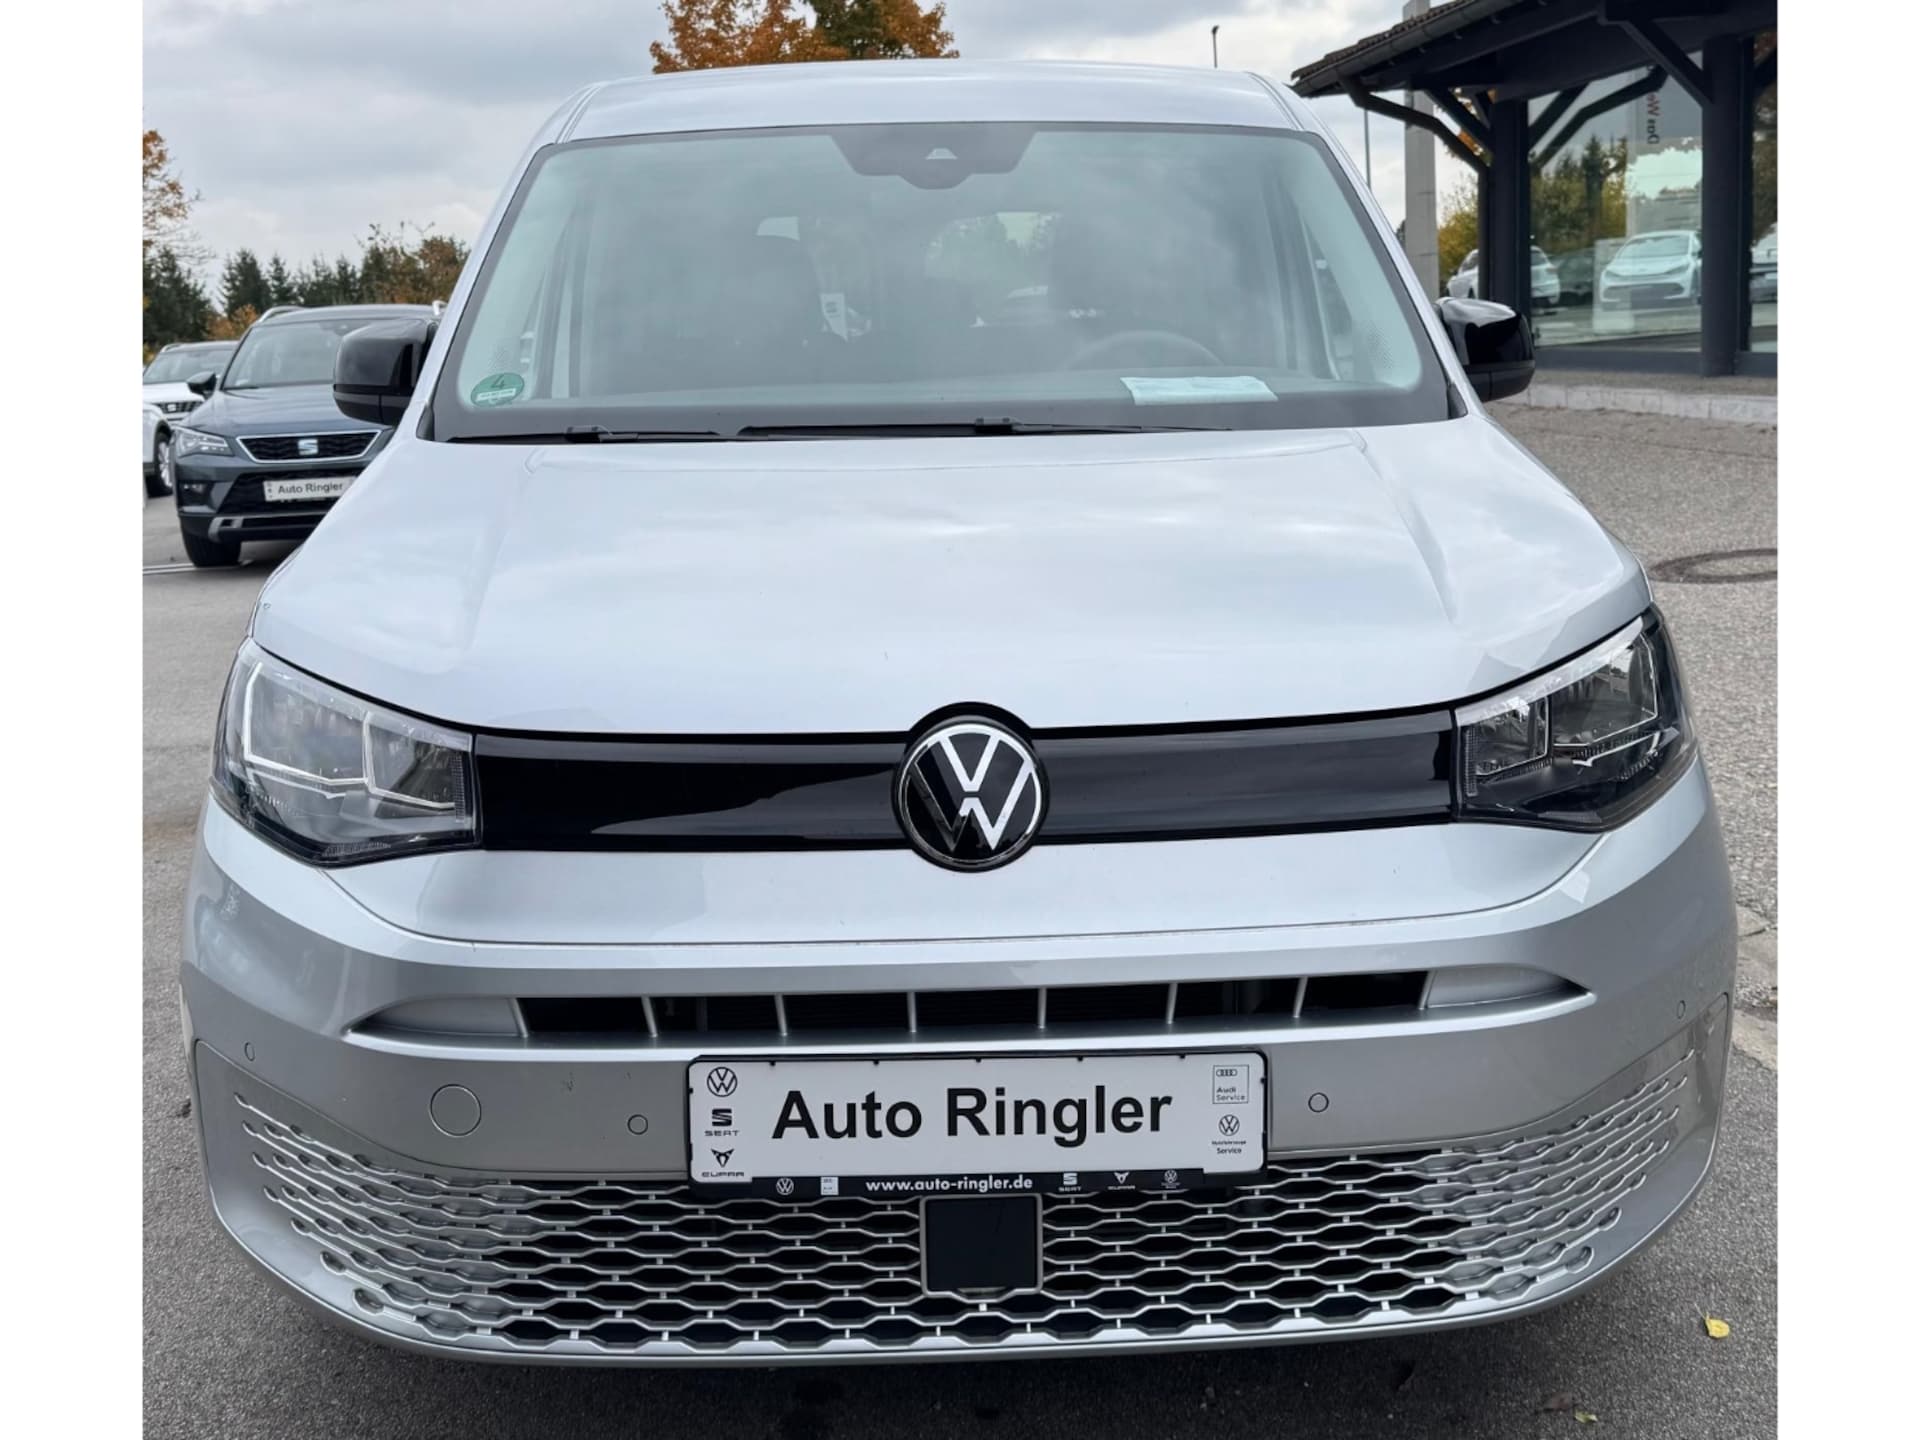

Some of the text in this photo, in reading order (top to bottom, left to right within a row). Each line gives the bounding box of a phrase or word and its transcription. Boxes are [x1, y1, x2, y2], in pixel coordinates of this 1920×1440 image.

[278, 482, 343, 494] Auto Ringler
[772, 1085, 1173, 1148] Auto Ringler
[866, 1174, 1033, 1193] www.auto-ringler.de
